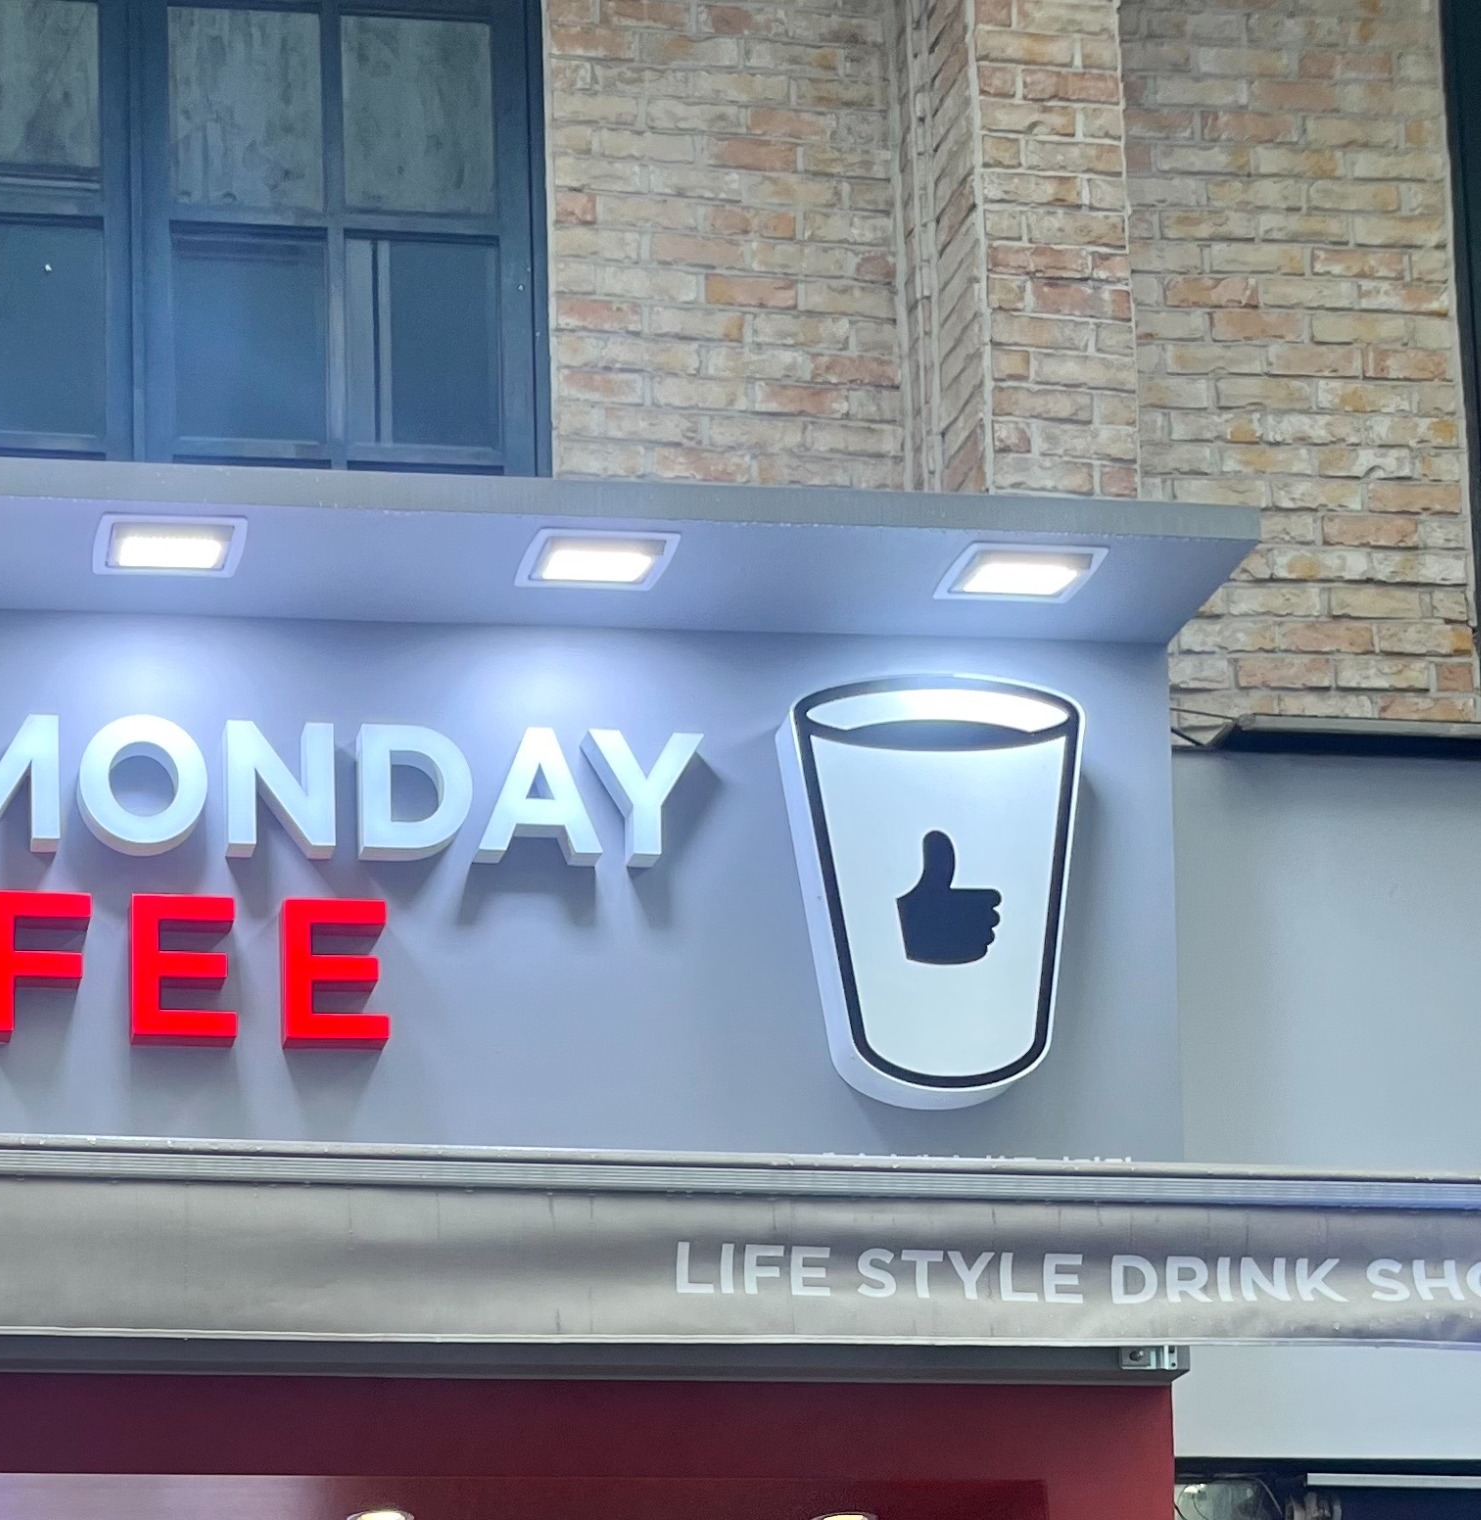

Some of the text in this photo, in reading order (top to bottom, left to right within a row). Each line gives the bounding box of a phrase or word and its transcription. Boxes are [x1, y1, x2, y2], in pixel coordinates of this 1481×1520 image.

[674, 1240, 832, 1298] LIFE
[856, 1245, 1085, 1304] STYLE
[1110, 1253, 1351, 1305] DRINK
